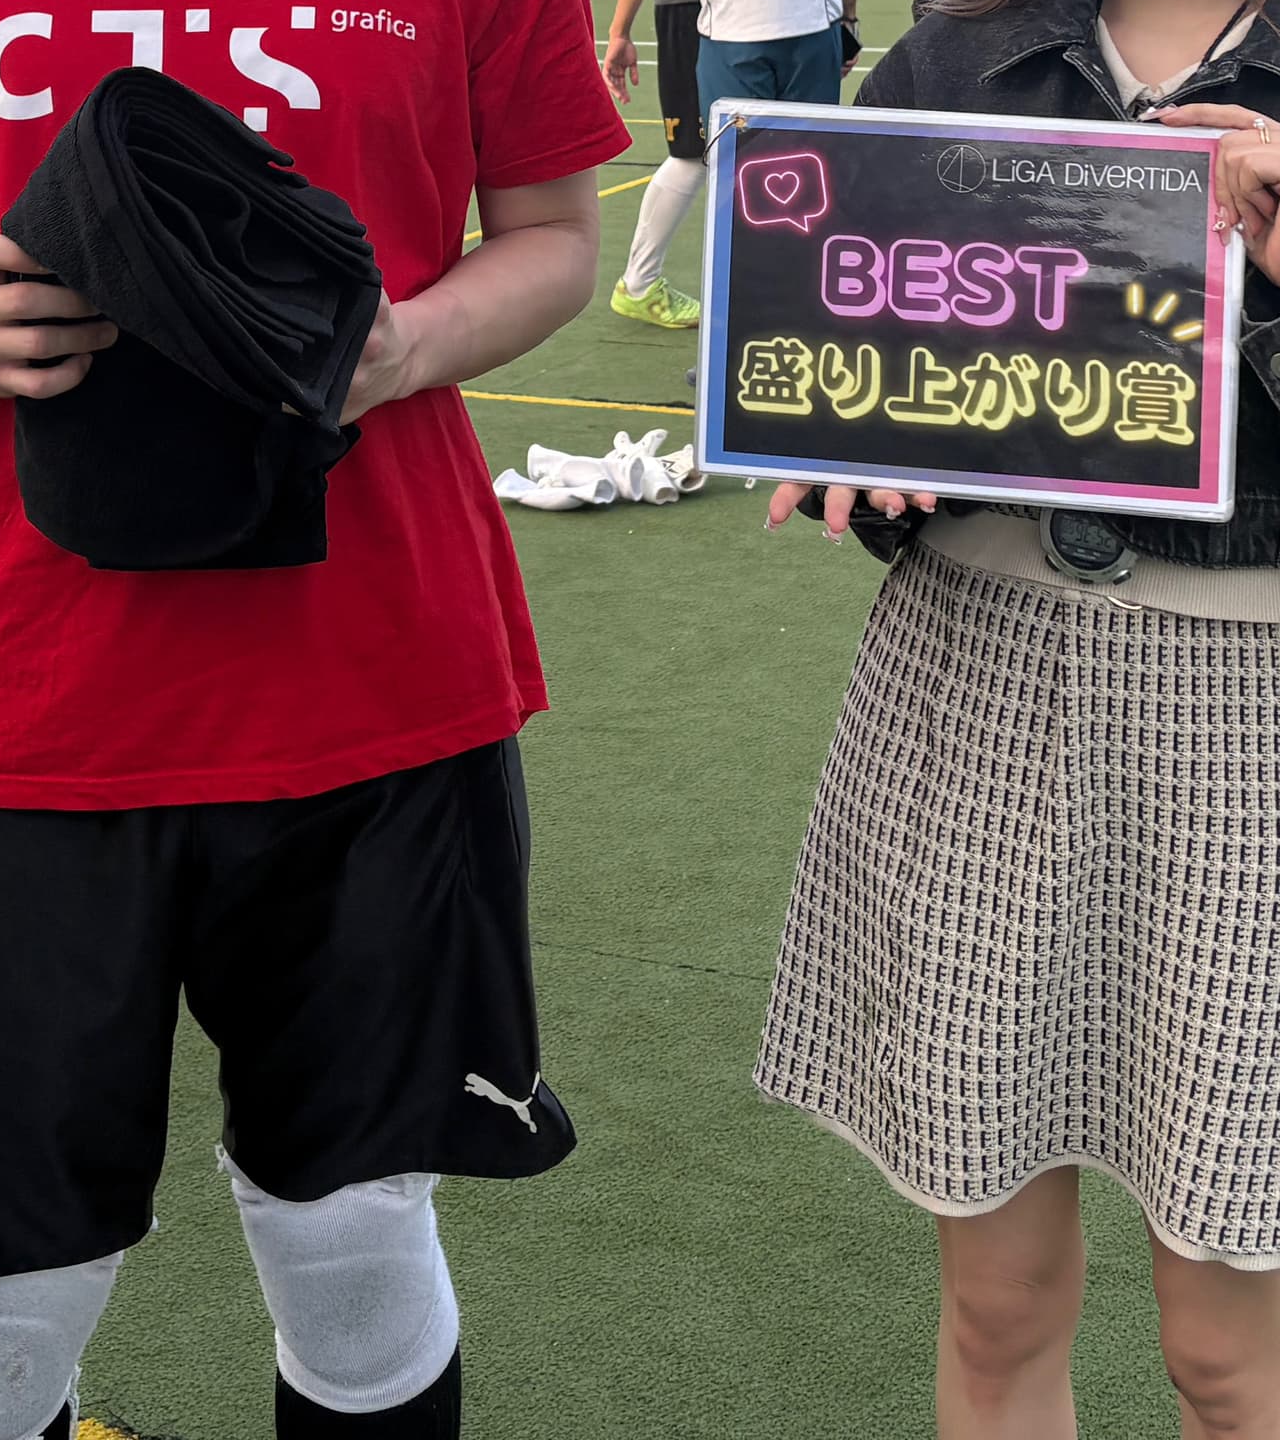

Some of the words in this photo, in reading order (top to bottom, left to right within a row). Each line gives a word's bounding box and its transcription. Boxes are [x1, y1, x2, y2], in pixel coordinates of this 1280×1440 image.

[331, 8, 416, 41] grafica
[821, 234, 1088, 332] BEST
[734, 335, 1197, 447] 盛り上がり賞
